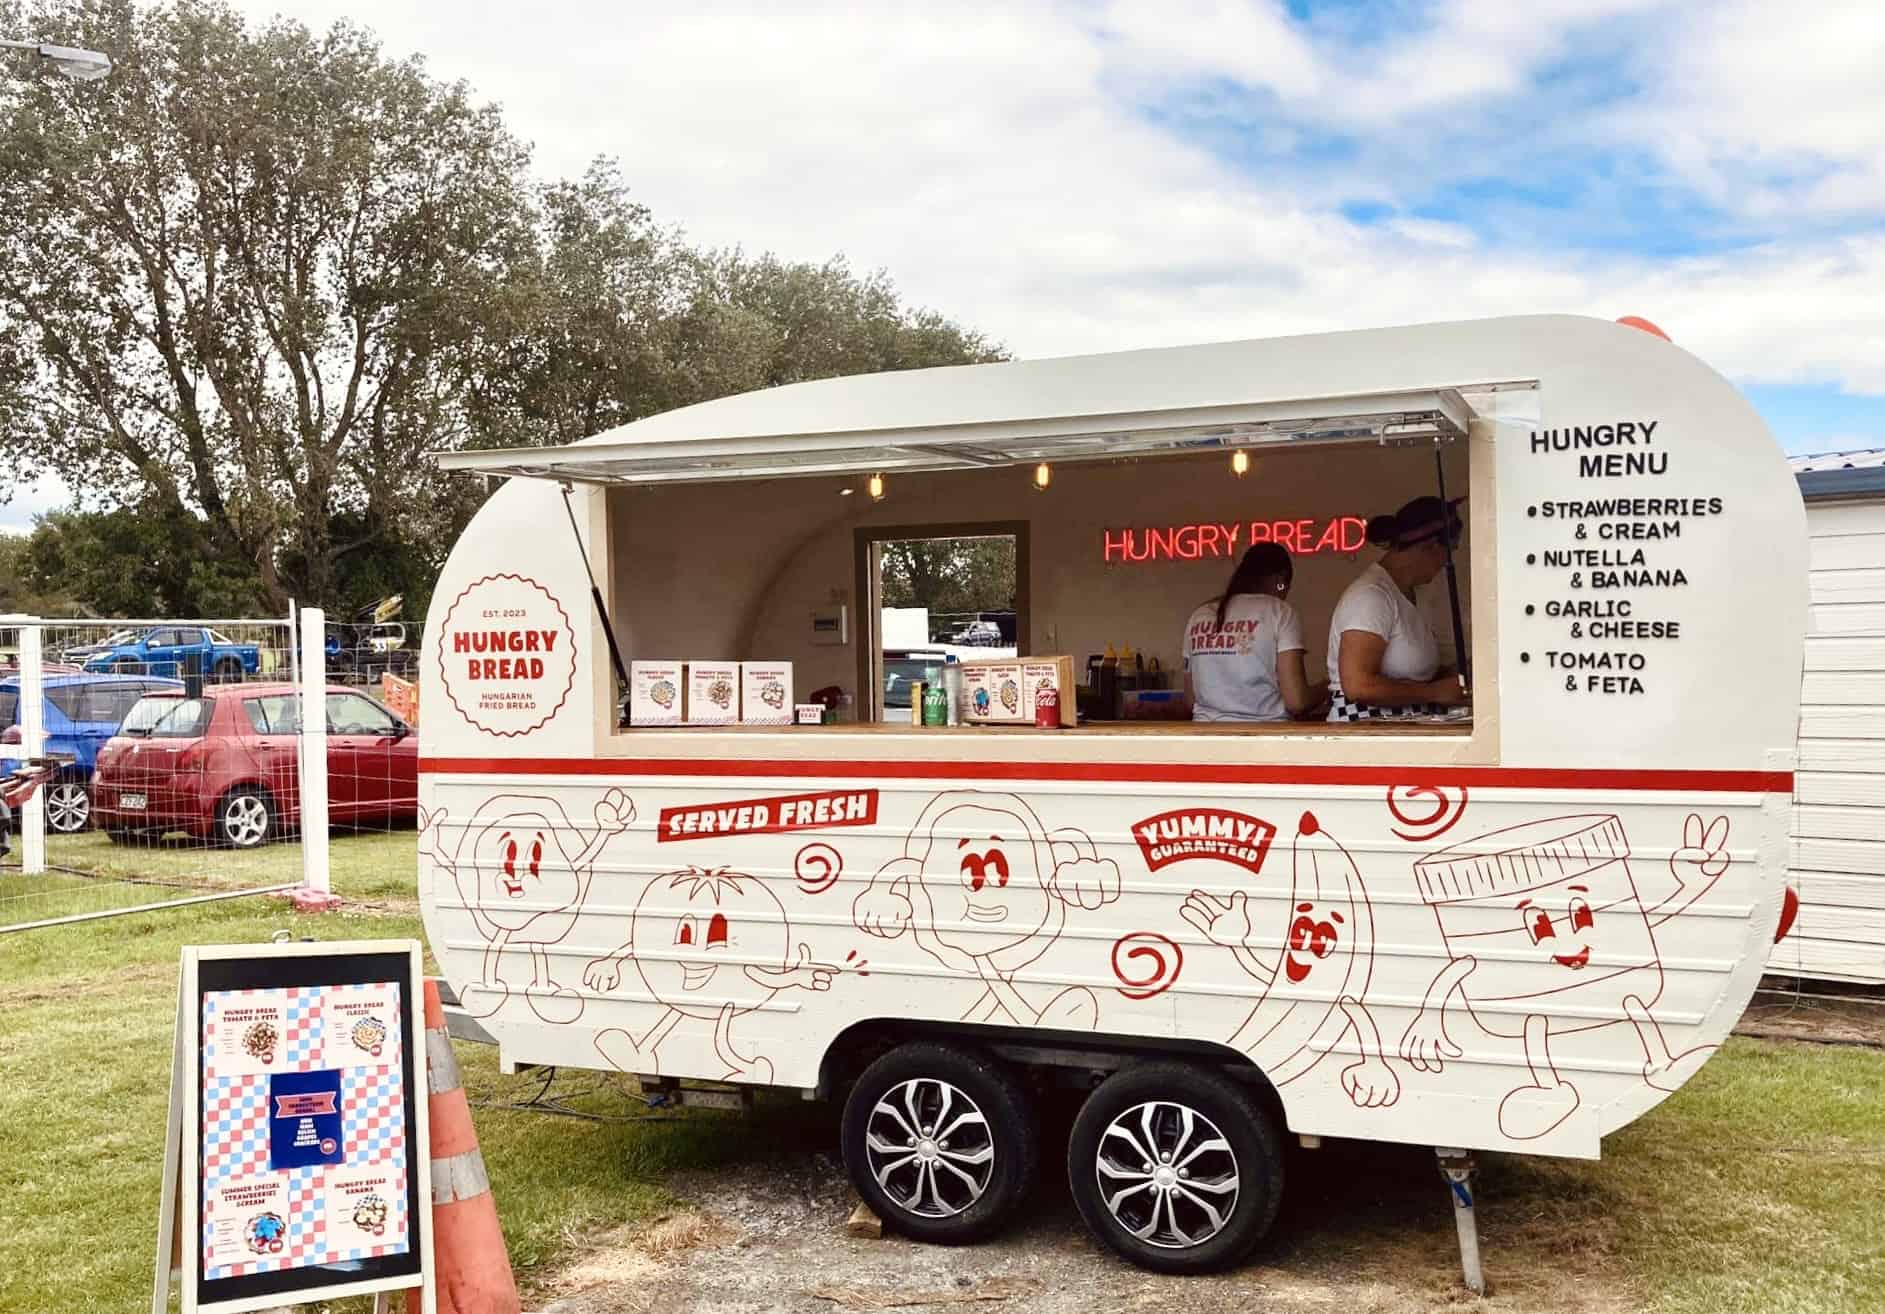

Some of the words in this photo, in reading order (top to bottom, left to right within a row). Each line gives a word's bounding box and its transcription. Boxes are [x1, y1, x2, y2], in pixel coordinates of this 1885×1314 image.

[1530, 421, 1658, 453] HUNGRY
[1579, 452, 1668, 478] MENU
[1541, 498, 1723, 519] STRAWBERRIES
[1104, 524, 1240, 561] HUNGRY
[1250, 517, 1367, 553] BREAD
[1574, 523, 1587, 540] &
[1598, 520, 1681, 540] CREAM
[1543, 549, 1646, 567] NUTELLA
[1570, 572, 1583, 589] &
[1591, 569, 1688, 589] BANANA
[482, 610, 500, 618] EST.
[503, 609, 527, 618] 2023
[1545, 600, 1632, 617] GARLIC
[1570, 622, 1583, 639] &
[1589, 621, 1680, 639] CHEESE
[454, 630, 558, 653] HUNGRY
[468, 658, 544, 680] BREAD
[1545, 652, 1646, 670] TOMATO
[1565, 675, 1578, 691] &
[1587, 676, 1645, 694] FETA
[479, 702, 504, 710] FRIED
[506, 702, 536, 710] BREAD
[481, 693, 533, 701] HUNGARIAN
[669, 805, 769, 836] SERVED
[779, 794, 868, 827] FRESH
[1140, 815, 1268, 847] YUMMY!
[1150, 840, 1258, 863] GUARANTEED
